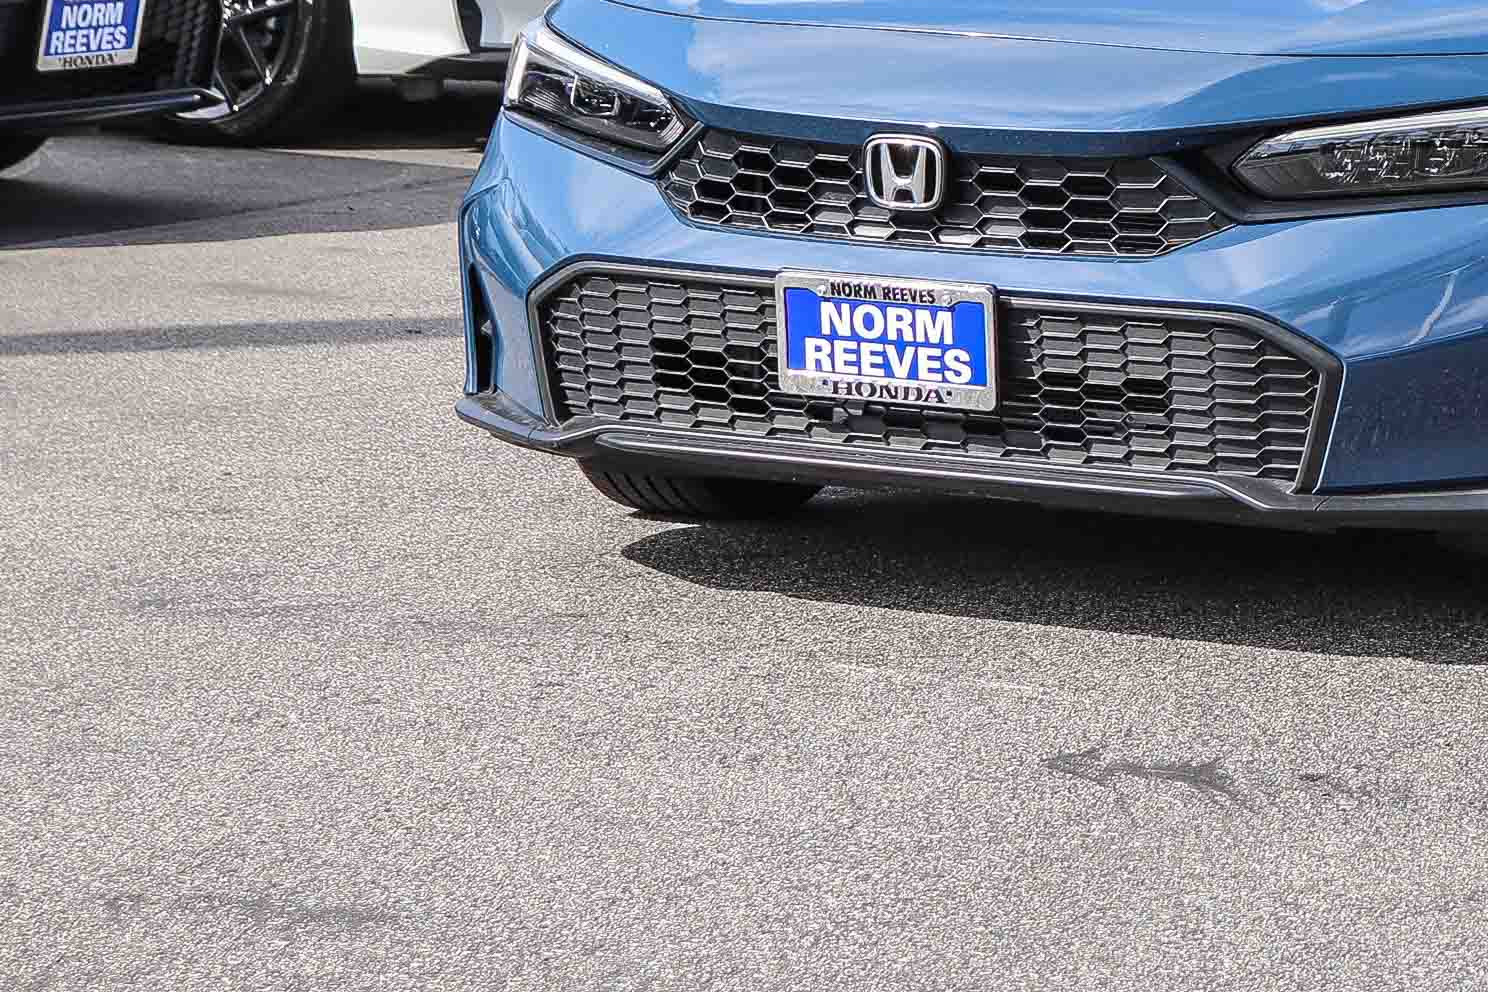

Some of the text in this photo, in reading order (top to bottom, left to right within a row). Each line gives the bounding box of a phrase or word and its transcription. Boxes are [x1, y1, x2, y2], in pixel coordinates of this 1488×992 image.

[61, 1, 125, 29] NORM
[49, 25, 128, 55] REEVES
[829, 281, 936, 305] NORM REEVES
[820, 301, 954, 345] NORM
[804, 337, 972, 384] REEVES
[831, 380, 948, 404] HONDA
